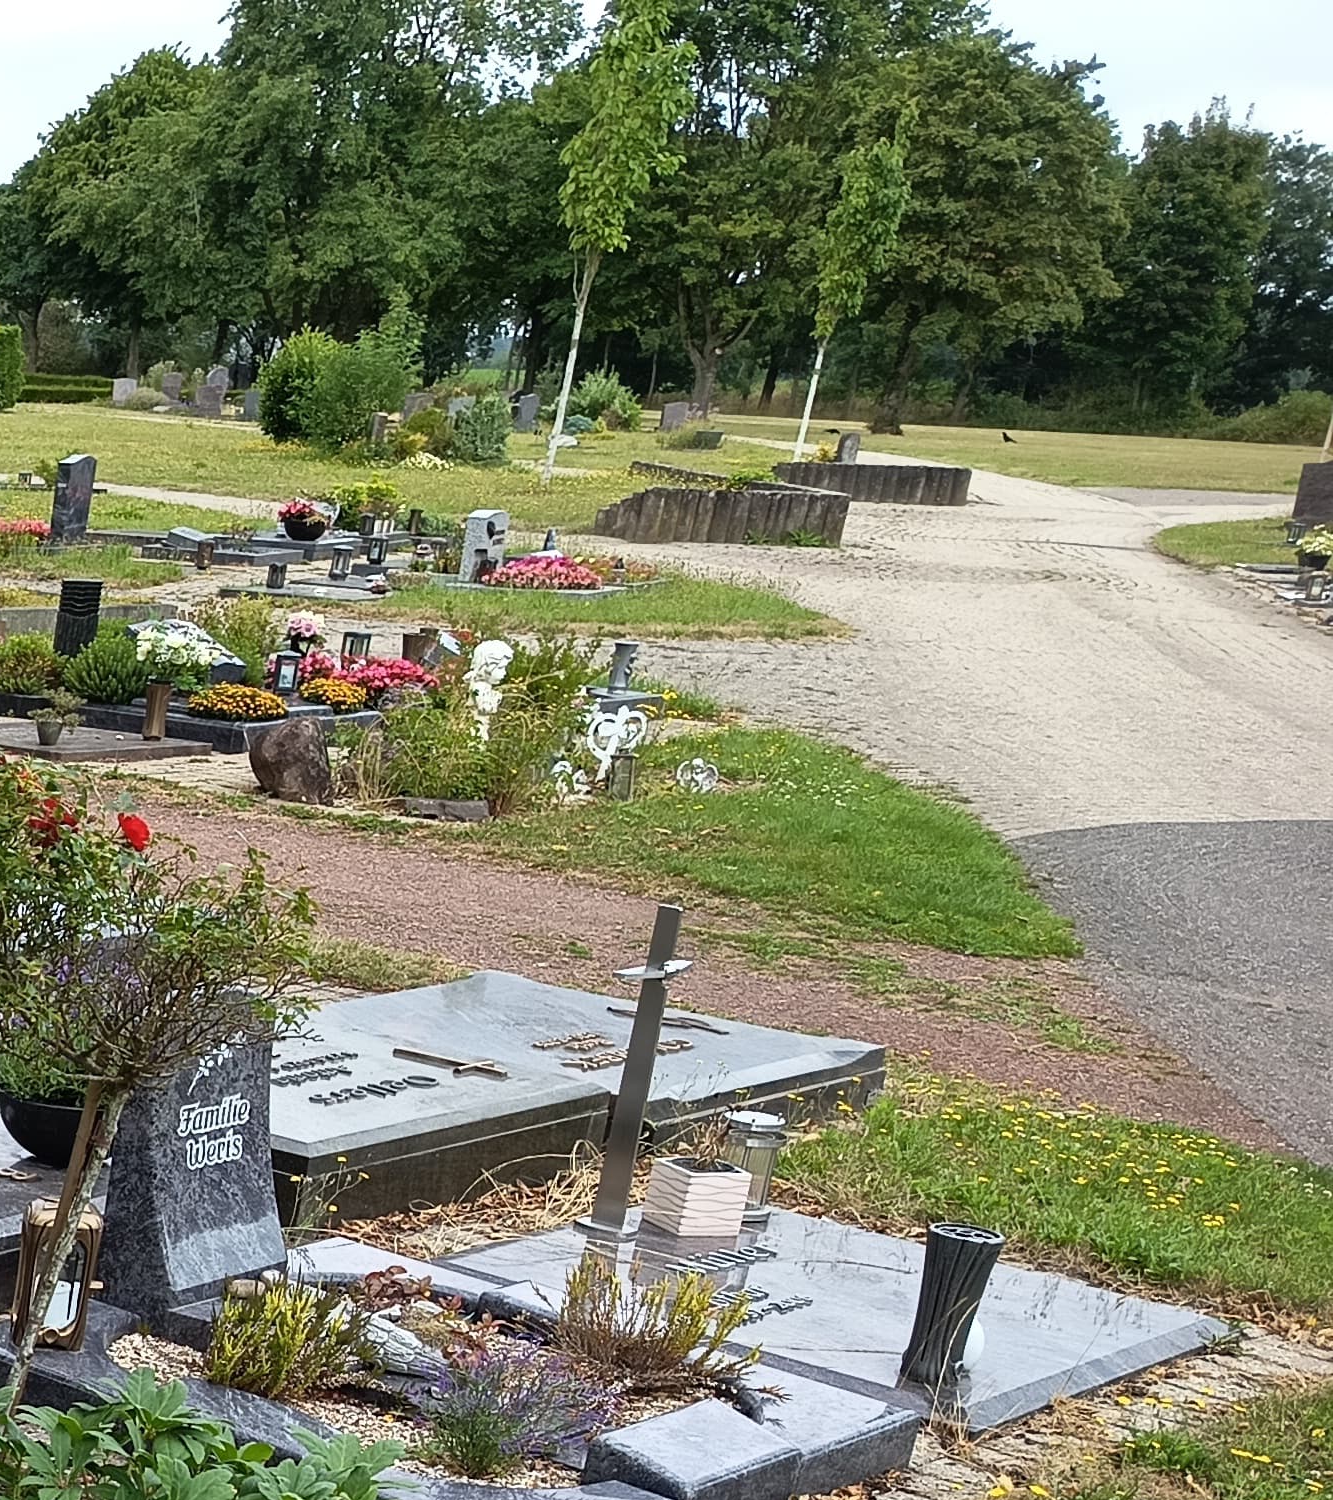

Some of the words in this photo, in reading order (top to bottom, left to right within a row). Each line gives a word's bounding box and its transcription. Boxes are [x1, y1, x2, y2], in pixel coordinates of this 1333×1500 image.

[177, 1093, 251, 1137] Familie
[185, 1127, 243, 1171] Weris
[664, 1242, 779, 1277] Müller
